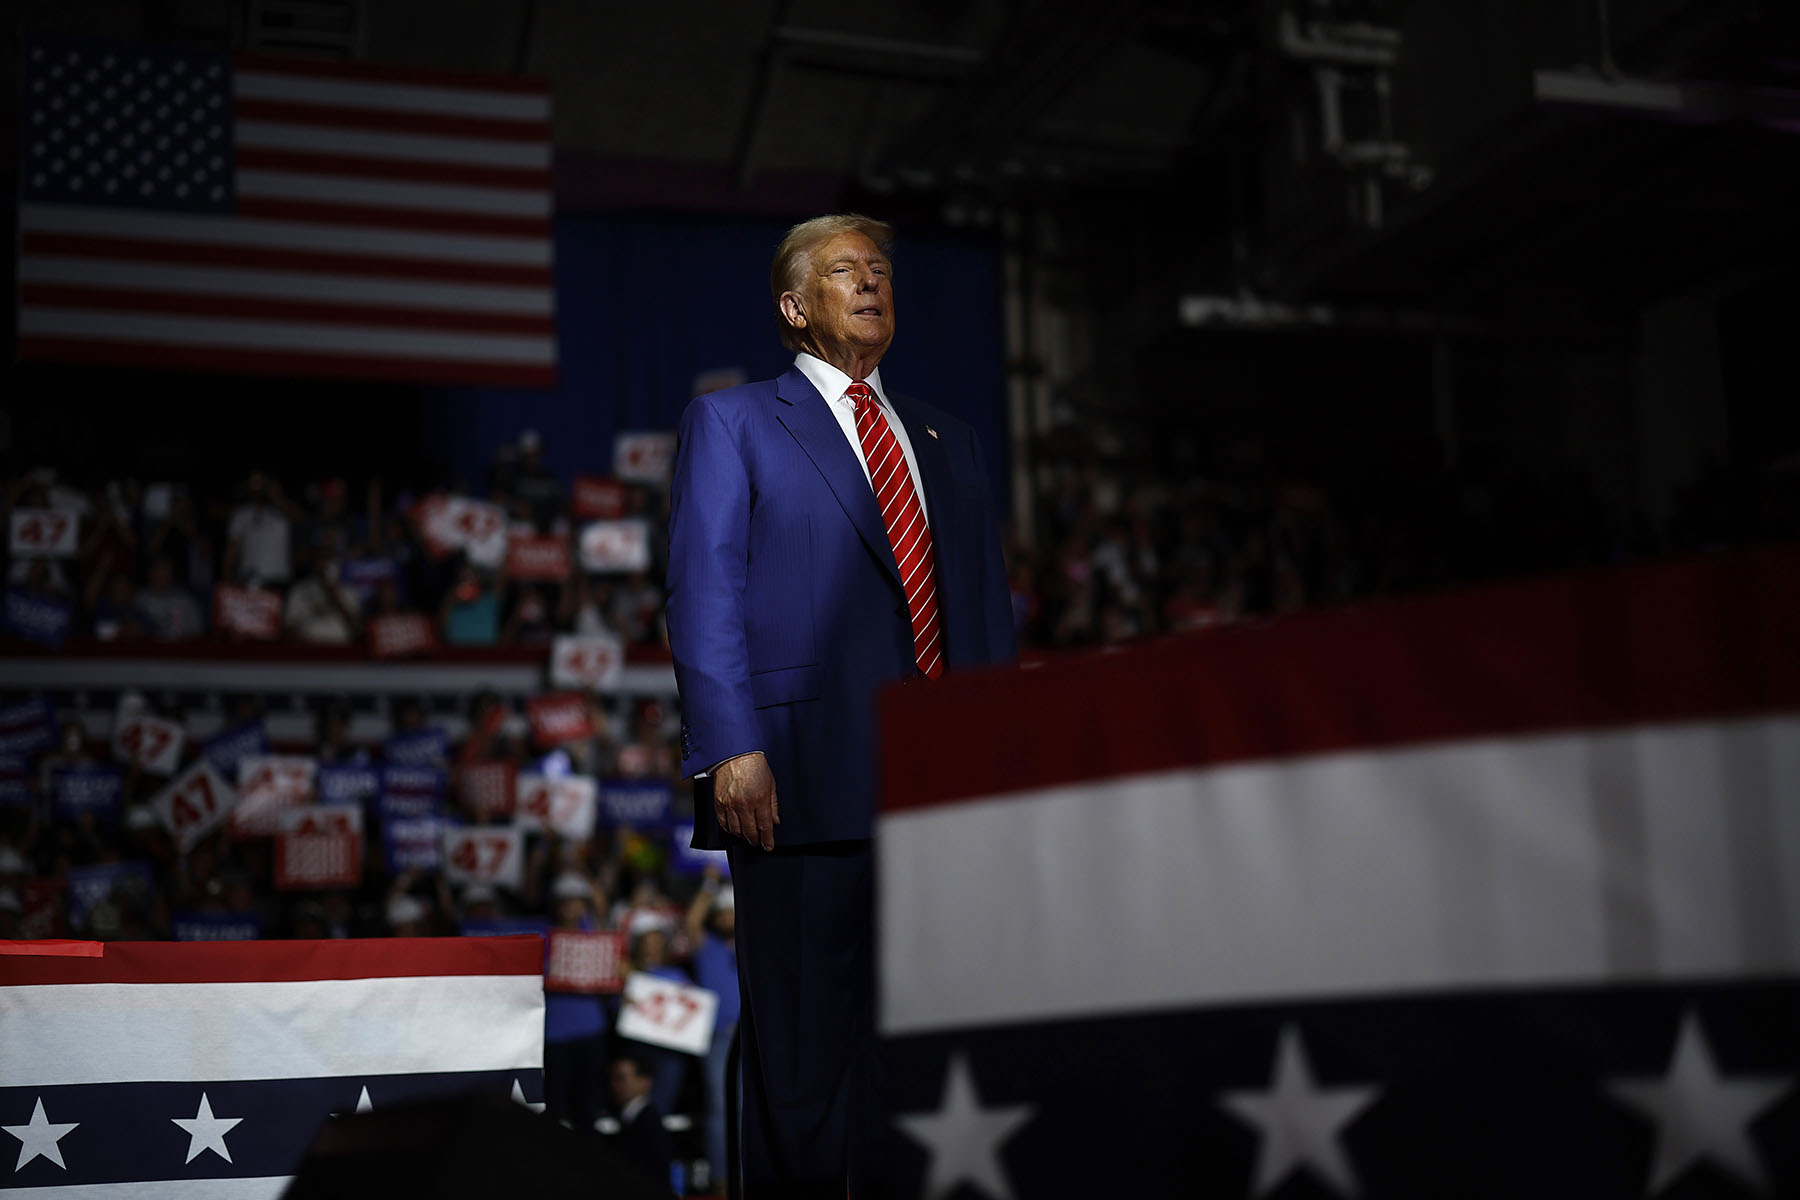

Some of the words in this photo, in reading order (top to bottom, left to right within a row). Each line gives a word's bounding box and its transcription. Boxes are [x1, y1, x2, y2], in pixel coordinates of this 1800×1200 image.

[20, 515, 66, 544] 47
[121, 721, 171, 759] 47
[172, 774, 215, 827] 47
[528, 788, 582, 822] 47
[453, 837, 509, 876] 47
[633, 992, 699, 1033] 47
